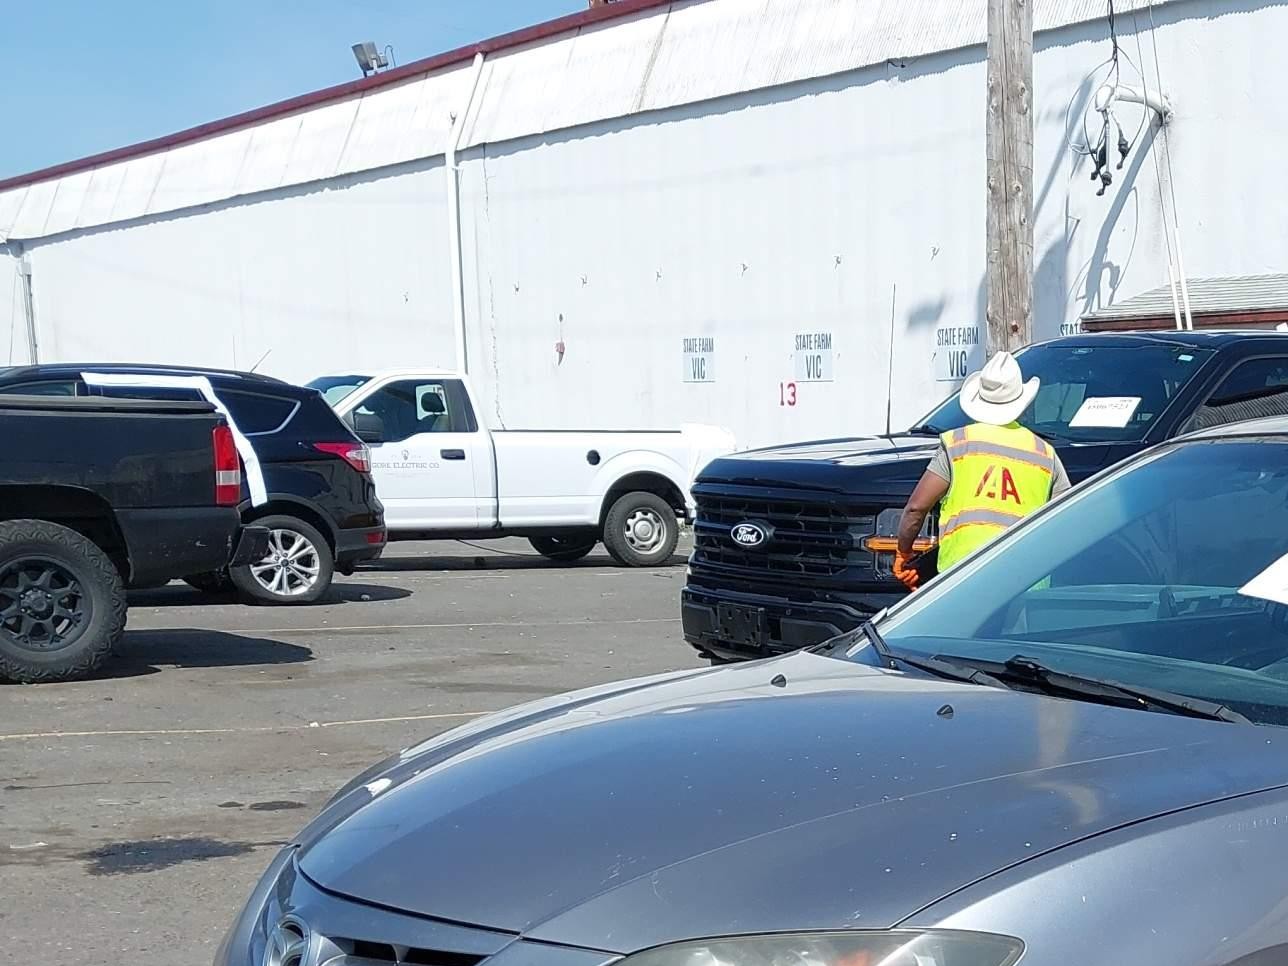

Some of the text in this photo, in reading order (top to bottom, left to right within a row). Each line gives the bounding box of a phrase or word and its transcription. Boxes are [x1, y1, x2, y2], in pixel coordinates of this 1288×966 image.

[683, 337, 714, 353] STATE FARM
[795, 332, 832, 350] STATE FARM
[937, 326, 979, 346] STATE FARM
[691, 357, 706, 379] VIC
[806, 355, 822, 379] VIC
[948, 351, 967, 377] VIC
[779, 382, 797, 406] 13
[737, 526, 758, 542] Ford
